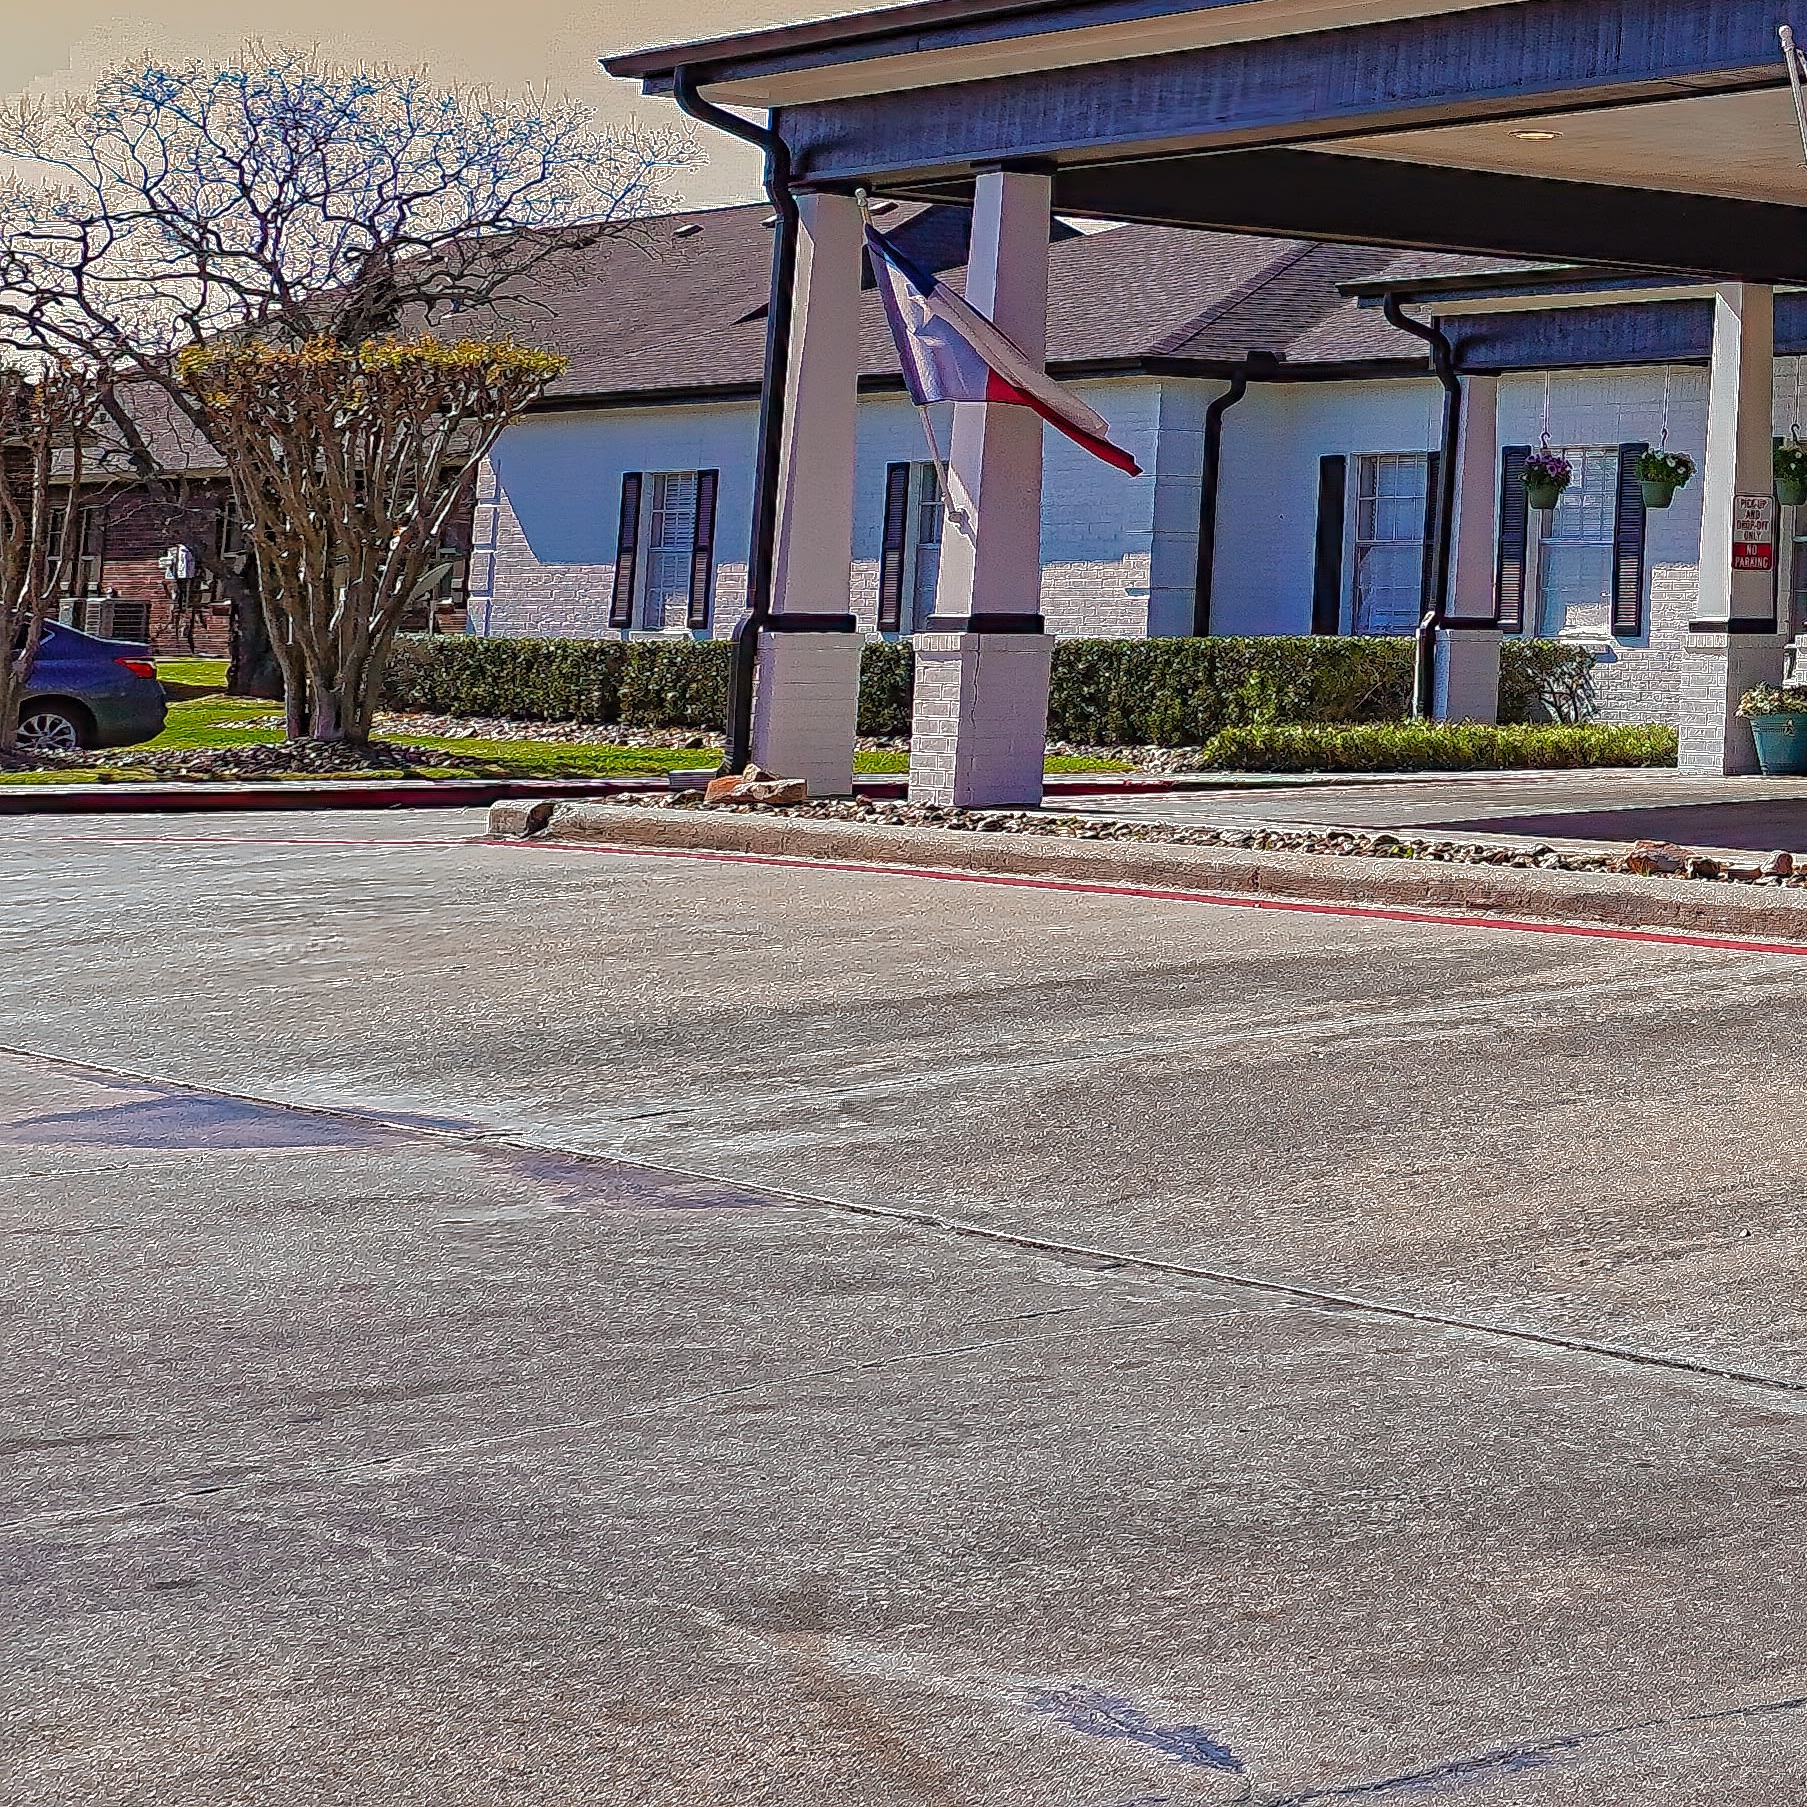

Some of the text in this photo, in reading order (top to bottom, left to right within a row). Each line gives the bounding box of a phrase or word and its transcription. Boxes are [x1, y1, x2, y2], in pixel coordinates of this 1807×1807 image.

[1745, 510, 1760, 519] AND
[1744, 531, 1761, 541] ONLY
[1746, 544, 1758, 555] NO
[1735, 556, 1769, 569] PARKING
